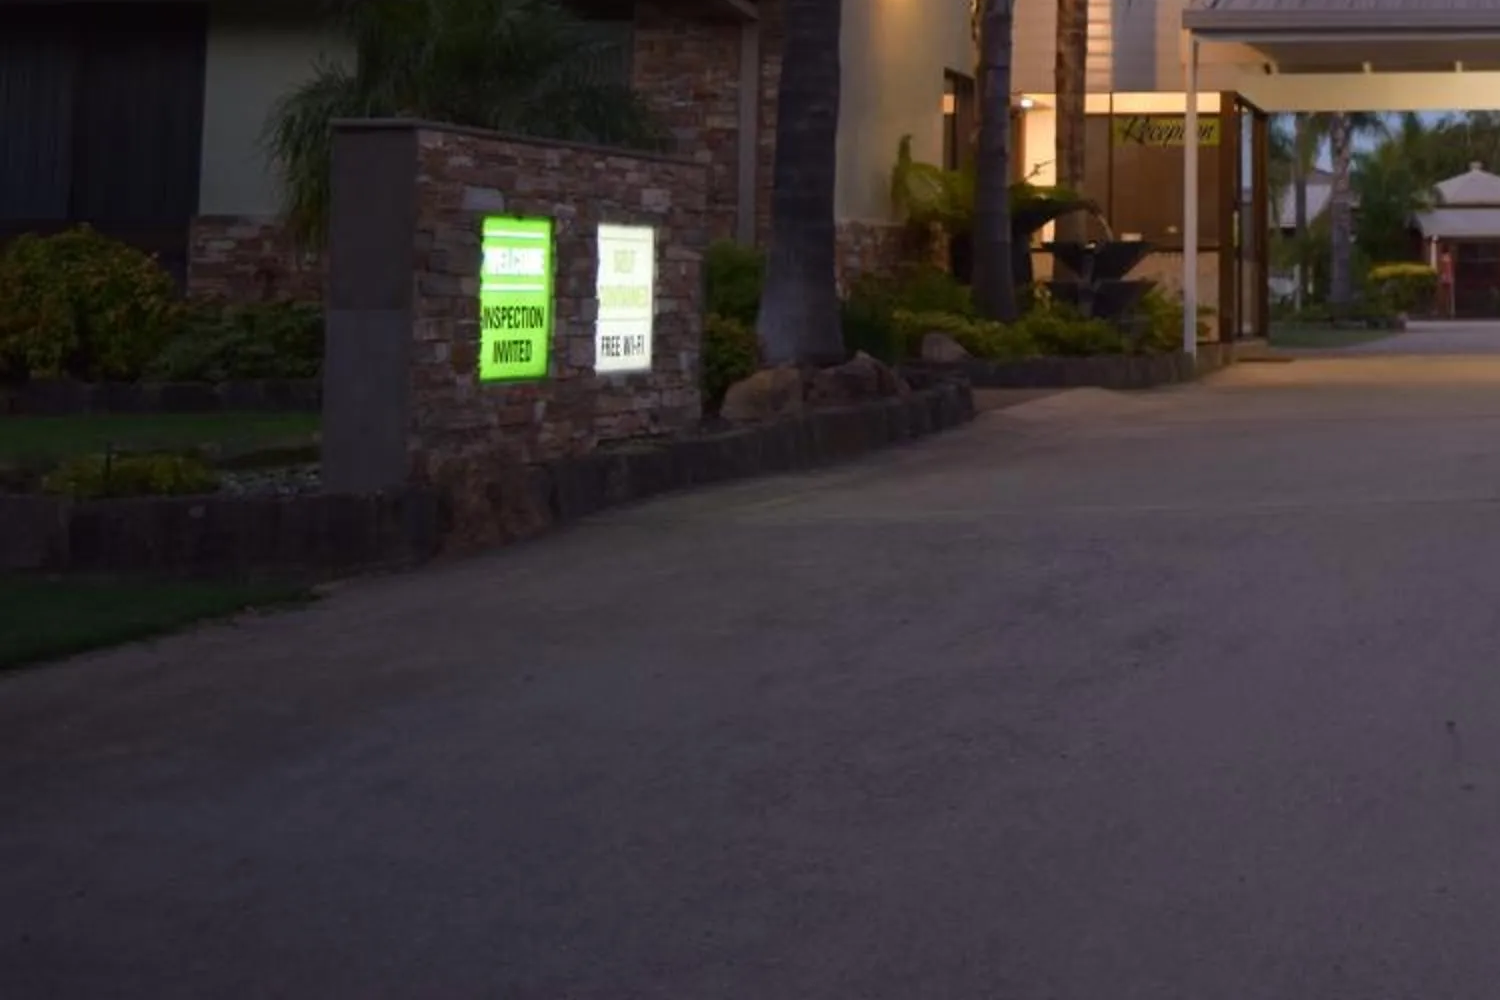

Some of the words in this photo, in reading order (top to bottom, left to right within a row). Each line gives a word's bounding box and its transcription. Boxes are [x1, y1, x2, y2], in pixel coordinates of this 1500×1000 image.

[483, 306, 544, 330] INSPECTION
[493, 340, 532, 363] INVITED
[601, 336, 621, 357] FREE
[623, 334, 645, 356] WI-FI
